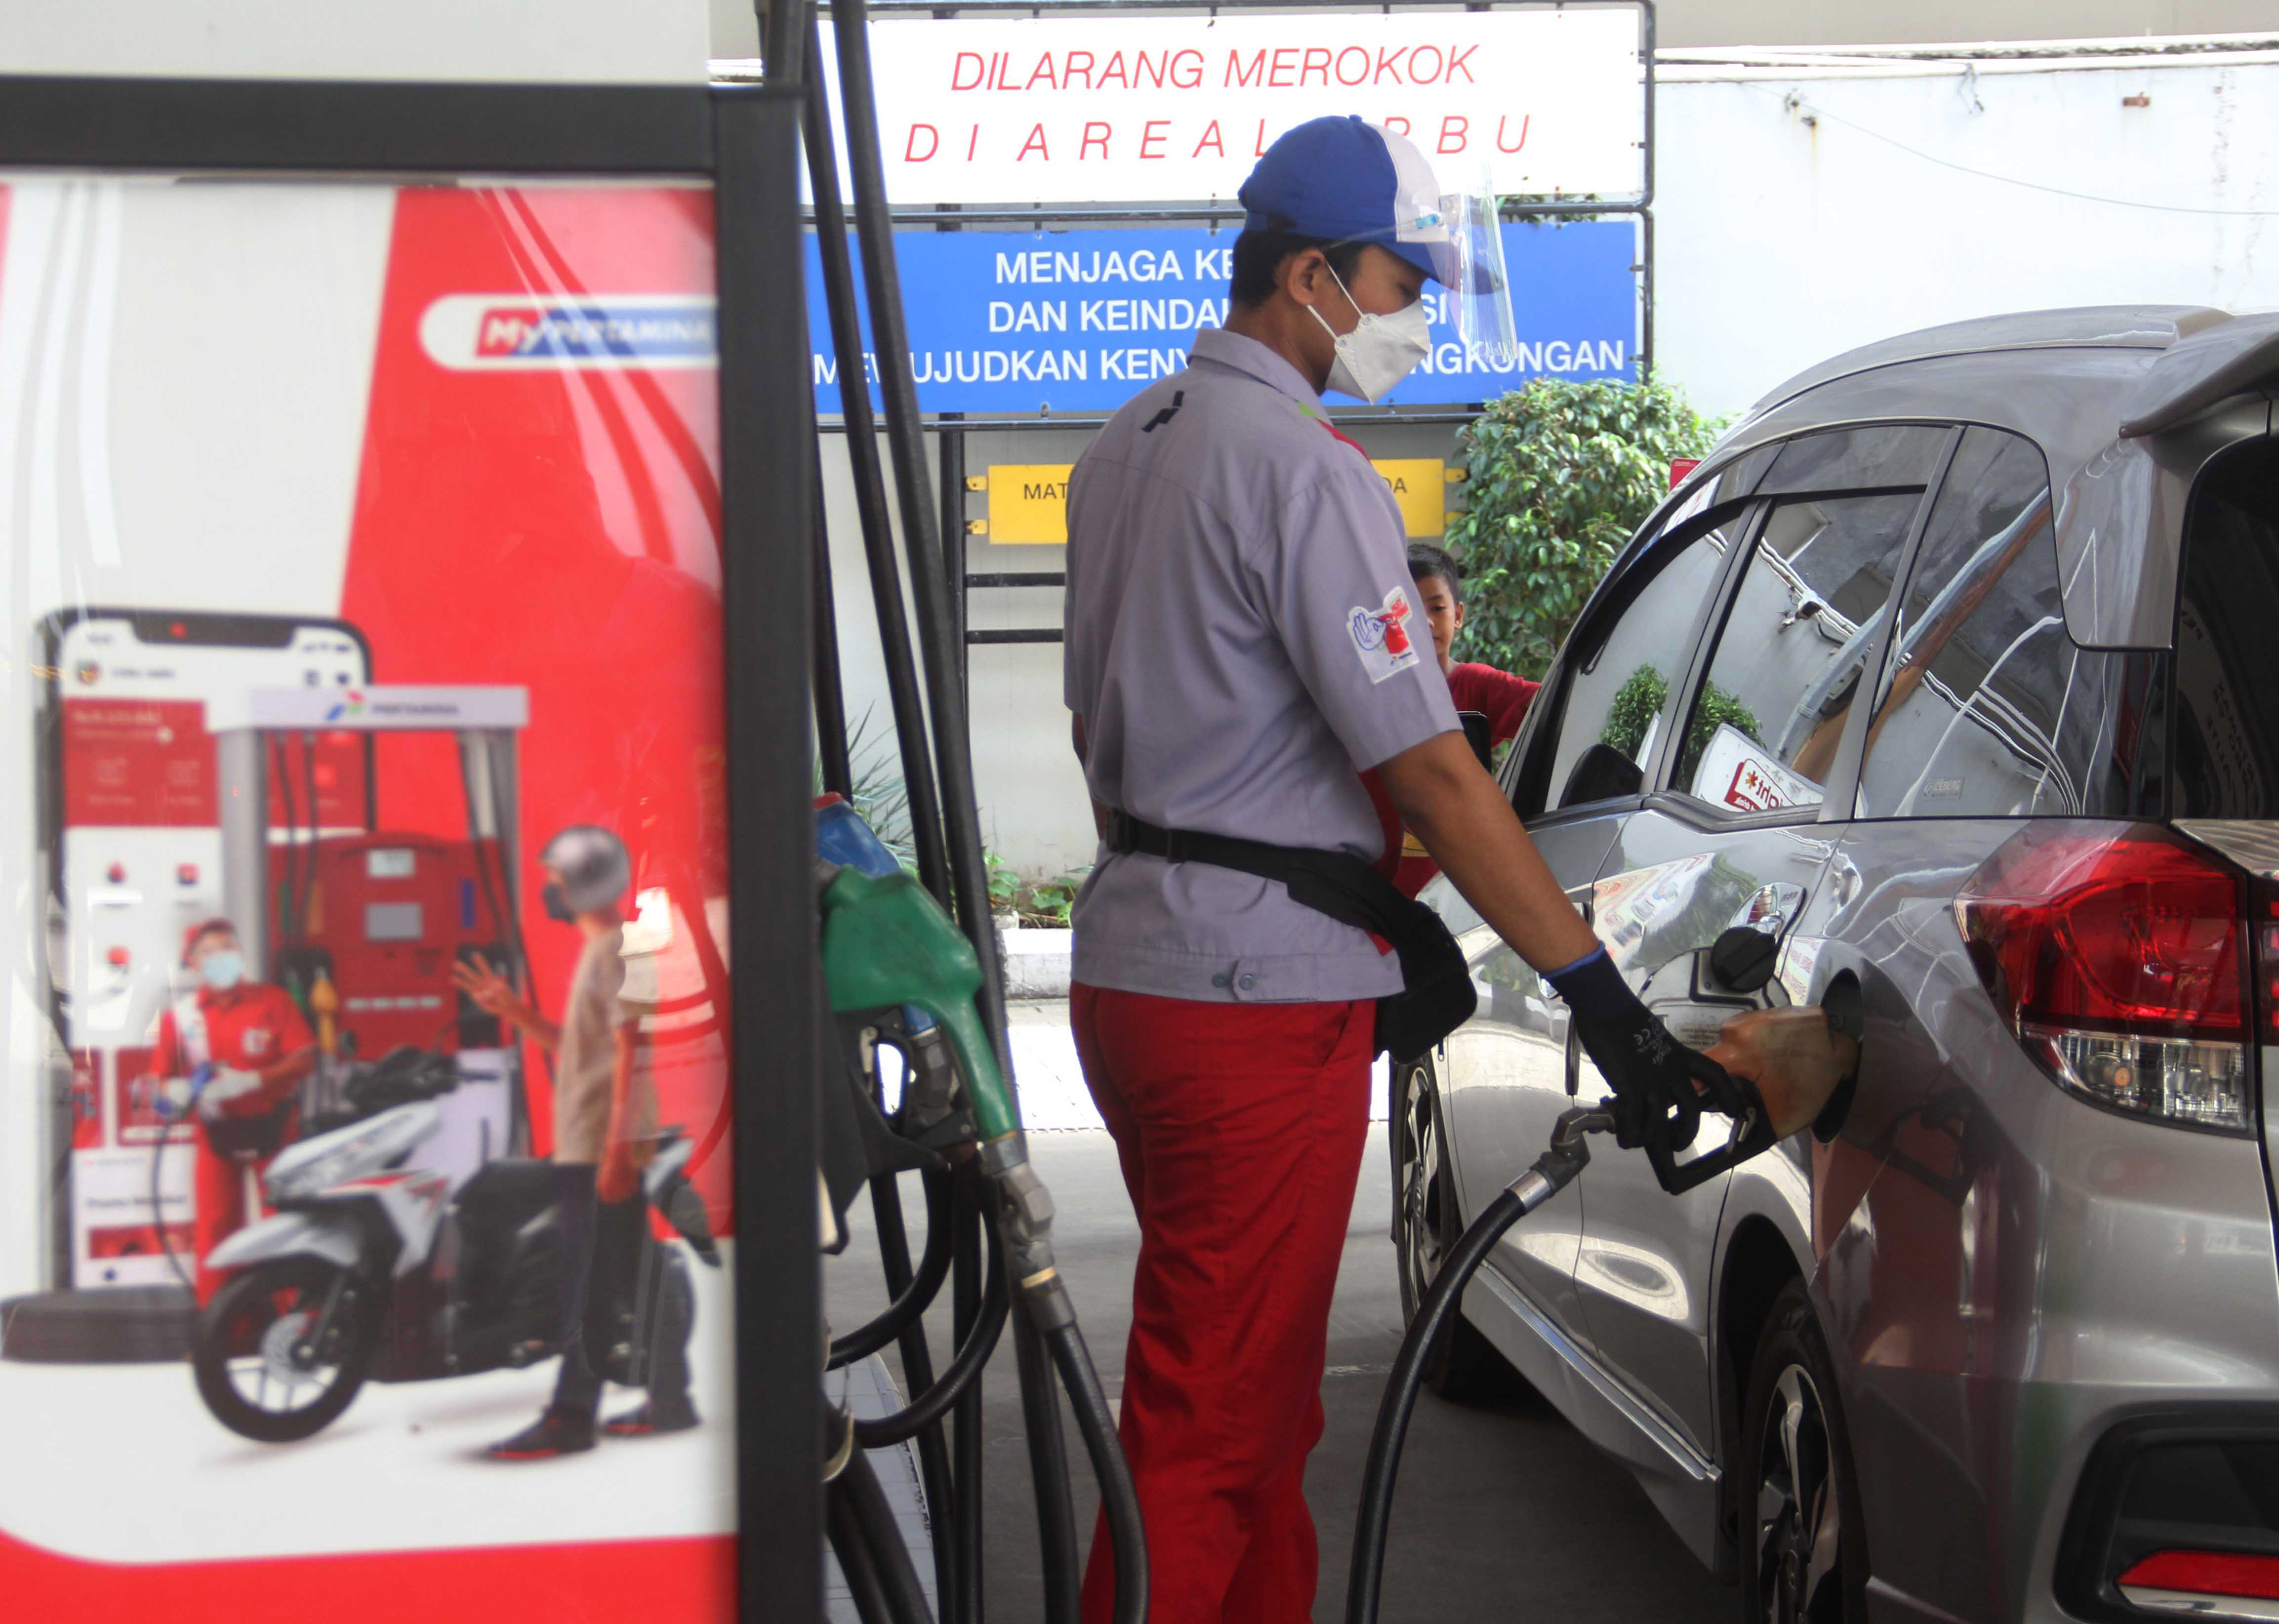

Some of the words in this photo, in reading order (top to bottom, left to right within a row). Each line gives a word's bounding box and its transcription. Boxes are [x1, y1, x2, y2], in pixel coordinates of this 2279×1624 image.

[952, 49, 1204, 91] DILARANG
[1224, 45, 1479, 87] MEROKOK
[996, 249, 1184, 283] MENJAGA
[989, 301, 1067, 332] DAN
